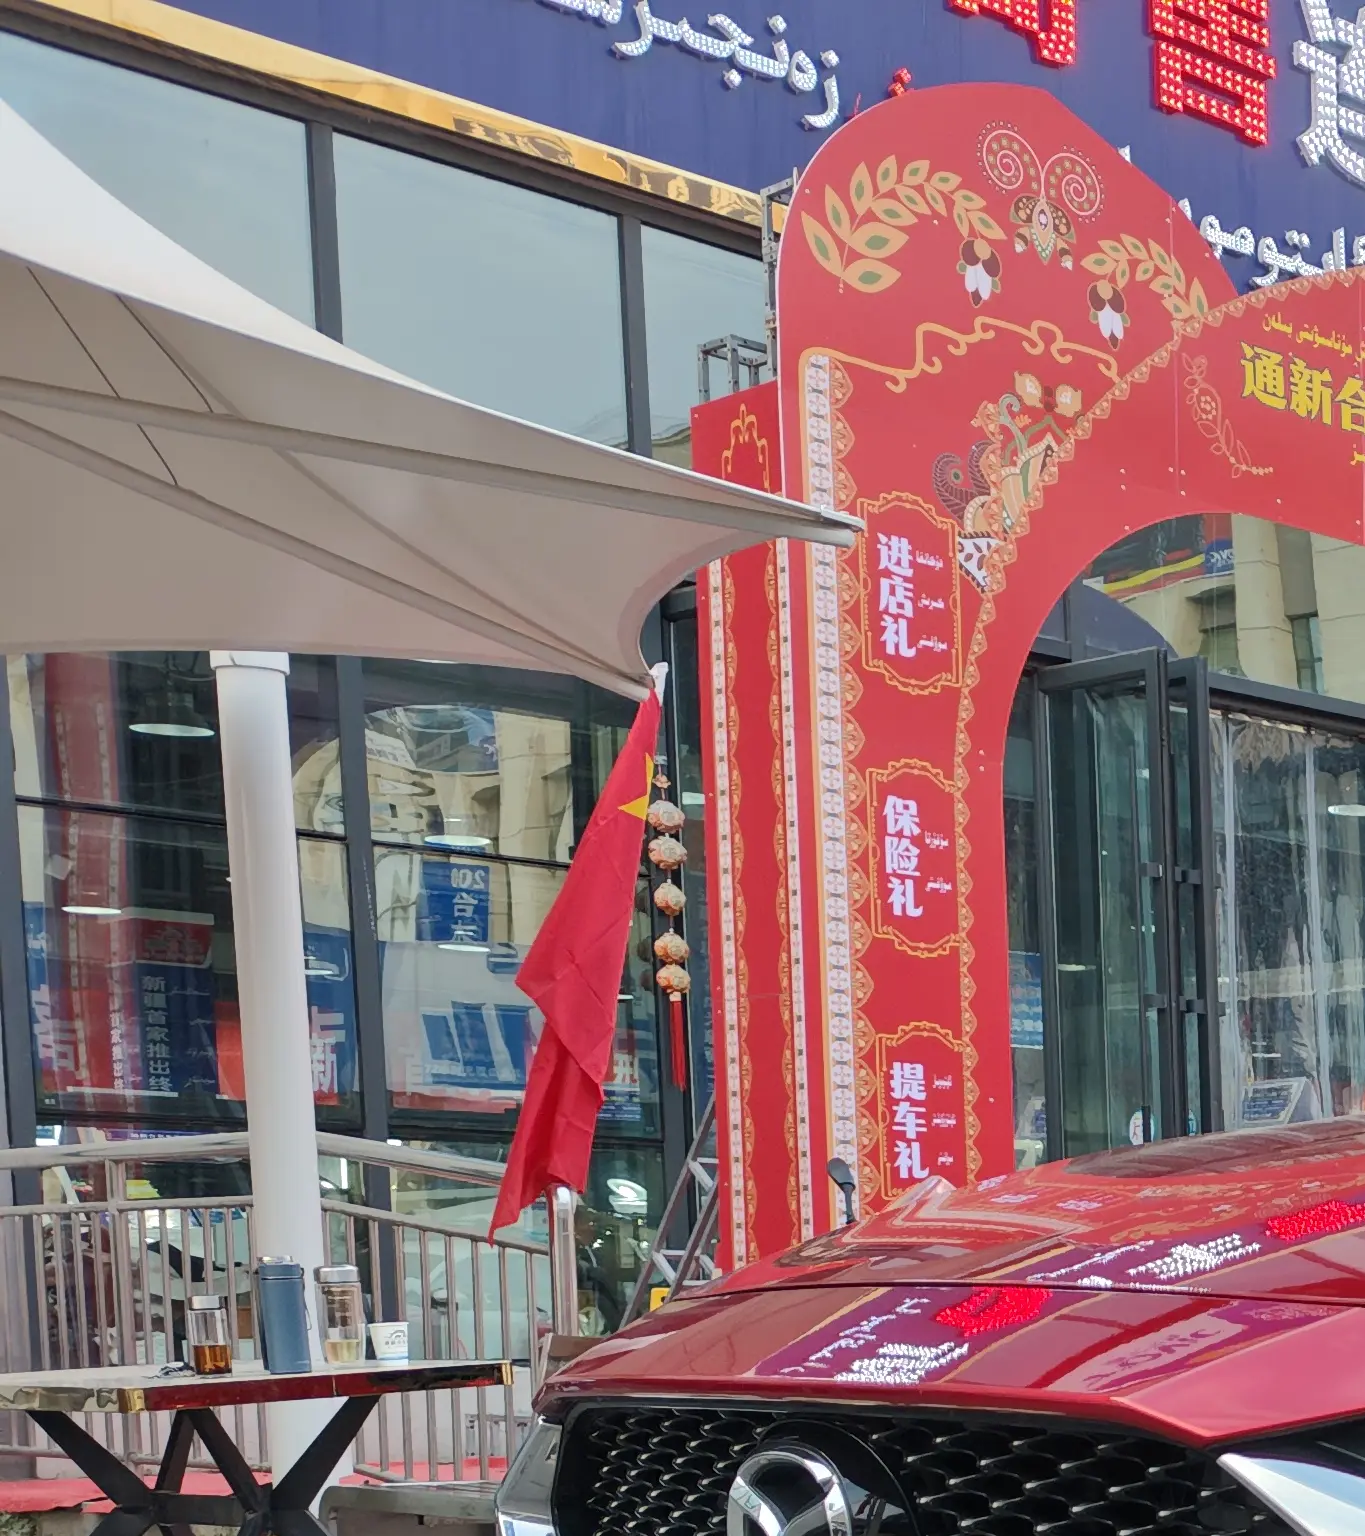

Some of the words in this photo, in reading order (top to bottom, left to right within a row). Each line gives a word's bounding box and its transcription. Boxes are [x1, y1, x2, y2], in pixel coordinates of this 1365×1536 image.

[876, 532, 917, 657] 进店礼
[882, 795, 923, 917] 保险礼
[889, 1062, 930, 1179] 提车礼
